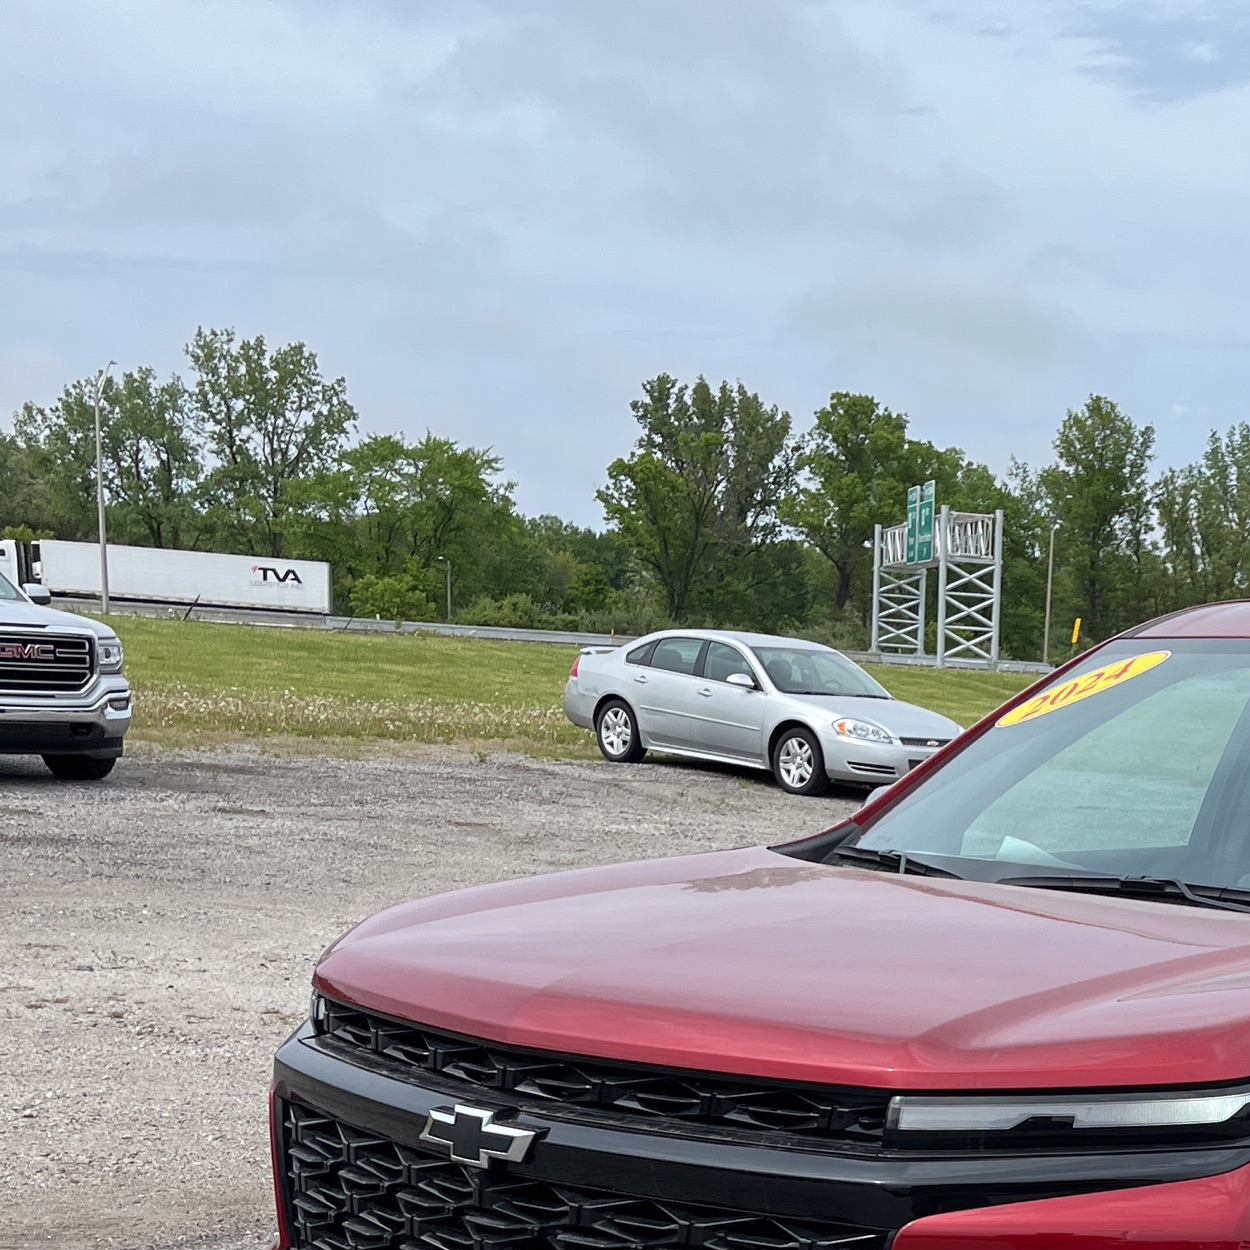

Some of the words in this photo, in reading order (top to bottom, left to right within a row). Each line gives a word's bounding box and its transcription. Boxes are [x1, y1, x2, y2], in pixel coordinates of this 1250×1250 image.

[258, 567, 303, 584] TVA
[0, 642, 54, 660] GMC
[1020, 658, 1137, 720] 2024
